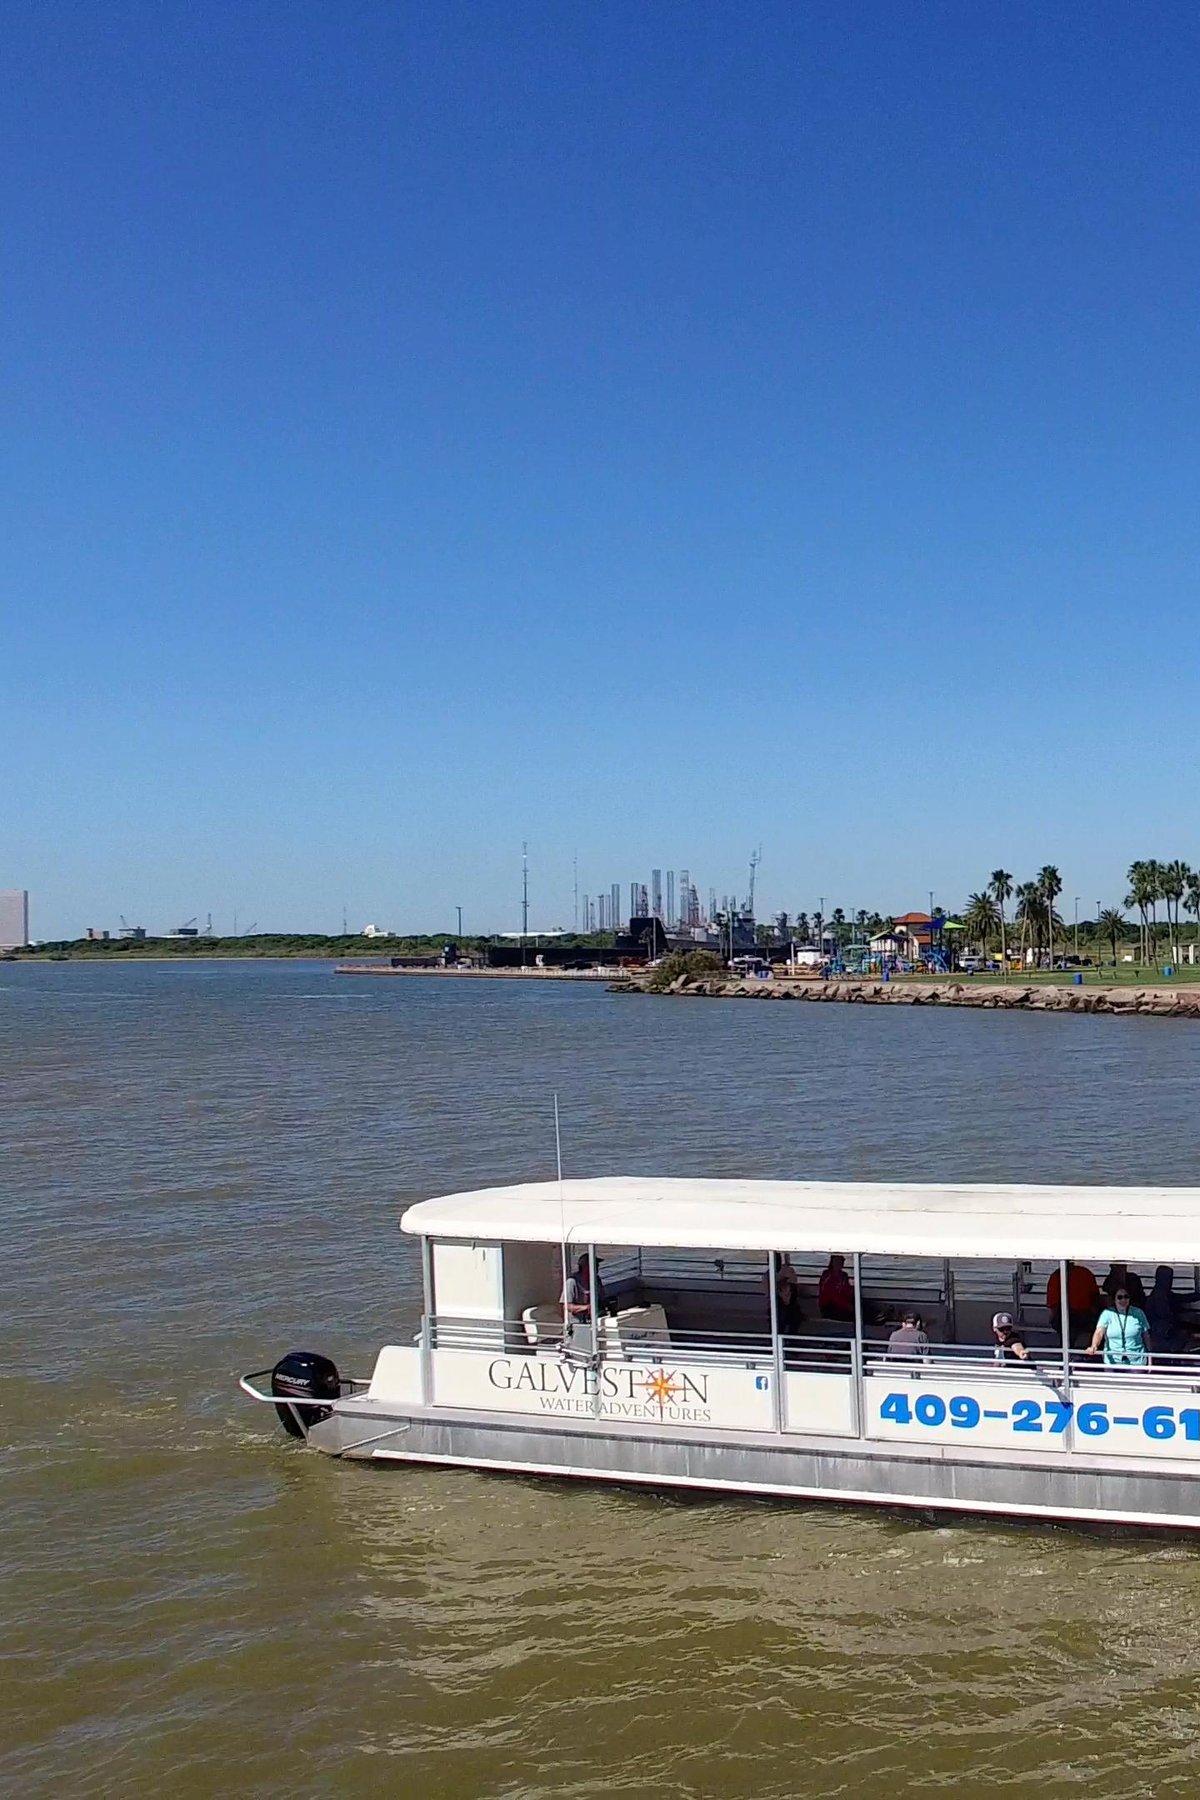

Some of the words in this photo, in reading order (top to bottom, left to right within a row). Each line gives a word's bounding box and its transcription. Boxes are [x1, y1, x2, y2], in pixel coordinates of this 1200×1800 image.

[275, 1373, 311, 1386] MERCURY
[540, 1397, 595, 1413] WATER
[598, 1402, 711, 1422] ADVENTURES
